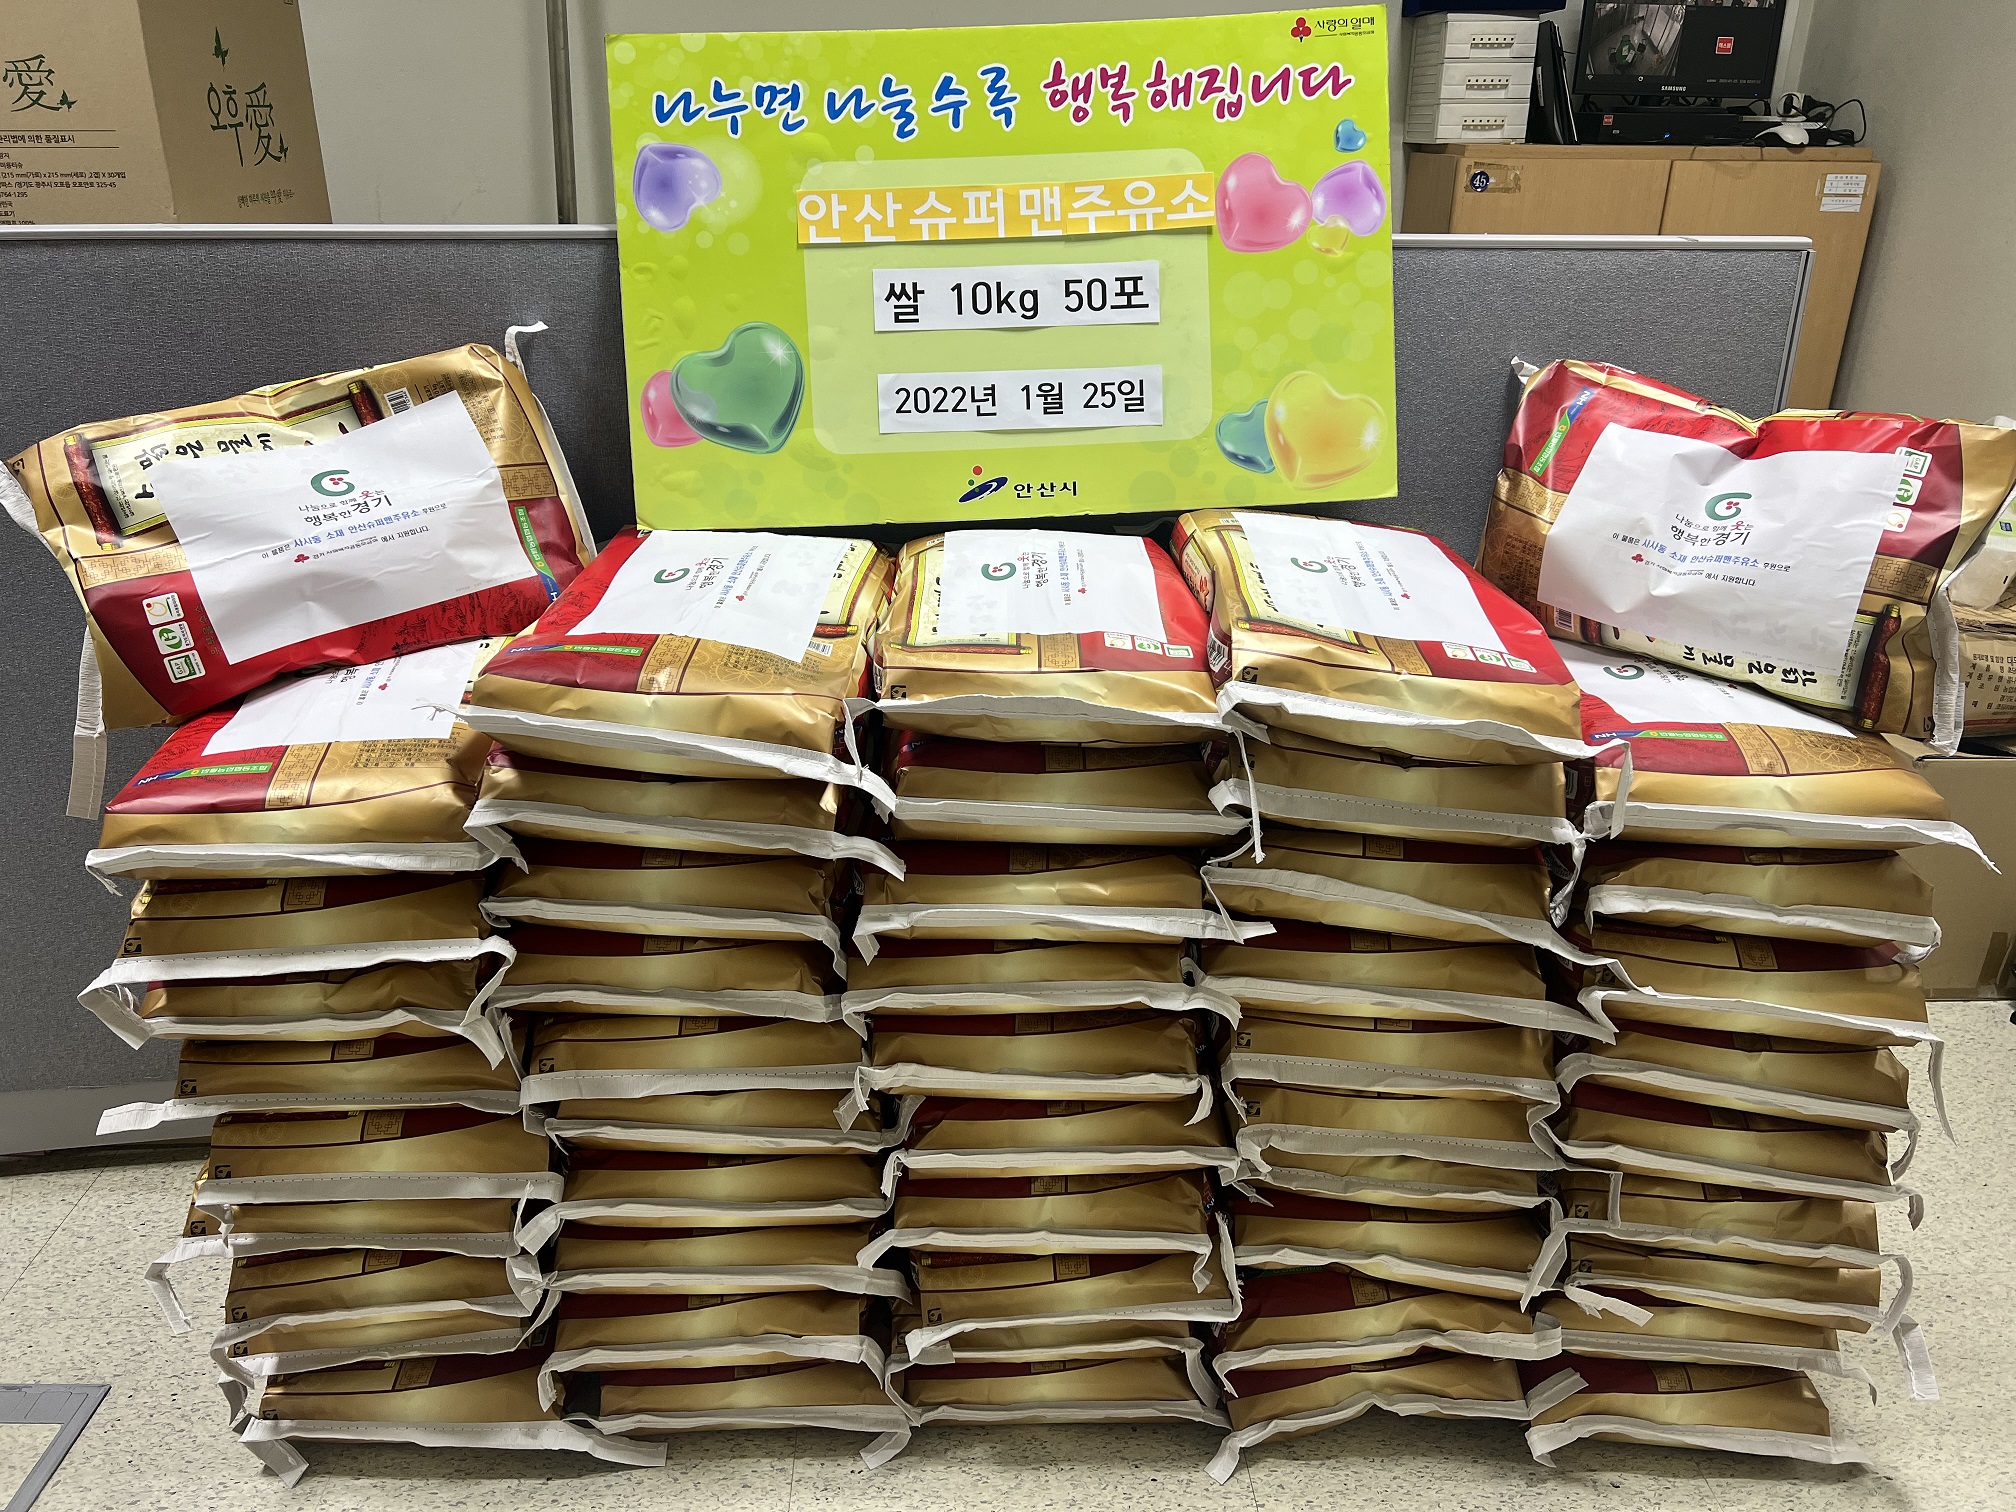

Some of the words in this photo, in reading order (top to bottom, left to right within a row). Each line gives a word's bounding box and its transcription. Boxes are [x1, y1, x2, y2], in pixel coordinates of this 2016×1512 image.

[1314, 19, 1348, 32] 사랑의
[1350, 16, 1375, 30] 열매
[3, 54, 60, 112] 愛
[653, 78, 808, 137] 나누면
[1473, 174, 1487, 187] 45
[798, 179, 1215, 243] 안산슈퍼맨주유소
[885, 281, 925, 324] 쌀
[949, 281, 1039, 320] 10kg
[1063, 275, 1150, 313] 50포
[894, 383, 998, 417] 2022년
[1020, 381, 1064, 416] 1월
[1082, 379, 1146, 413] 25일
[1576, 390, 1591, 406] NH
[1013, 480, 1078, 499] 안산시
[299, 502, 337, 512] 나눔으로
[339, 497, 357, 506] 함께
[359, 489, 385, 500] 웃는
[293, 535, 322, 548] 사사동
[326, 529, 346, 540] 소재
[348, 509, 422, 535] 안산슈퍼맨주유소
[422, 502, 448, 515] 후원으로
[1675, 513, 1709, 532] 나눔으로
[1730, 520, 1754, 531] 웃는
[380, 533, 395, 543] 에서
[1642, 538, 1668, 554] 사사동
[1669, 551, 1688, 564] 소재
[1690, 554, 1760, 568] 안산슈퍼맨주유소
[1762, 562, 1791, 573] 후원으로
[1705, 572, 1719, 580] 에서
[174, 662, 184, 675] GAP
[137, 774, 160, 786] NH
